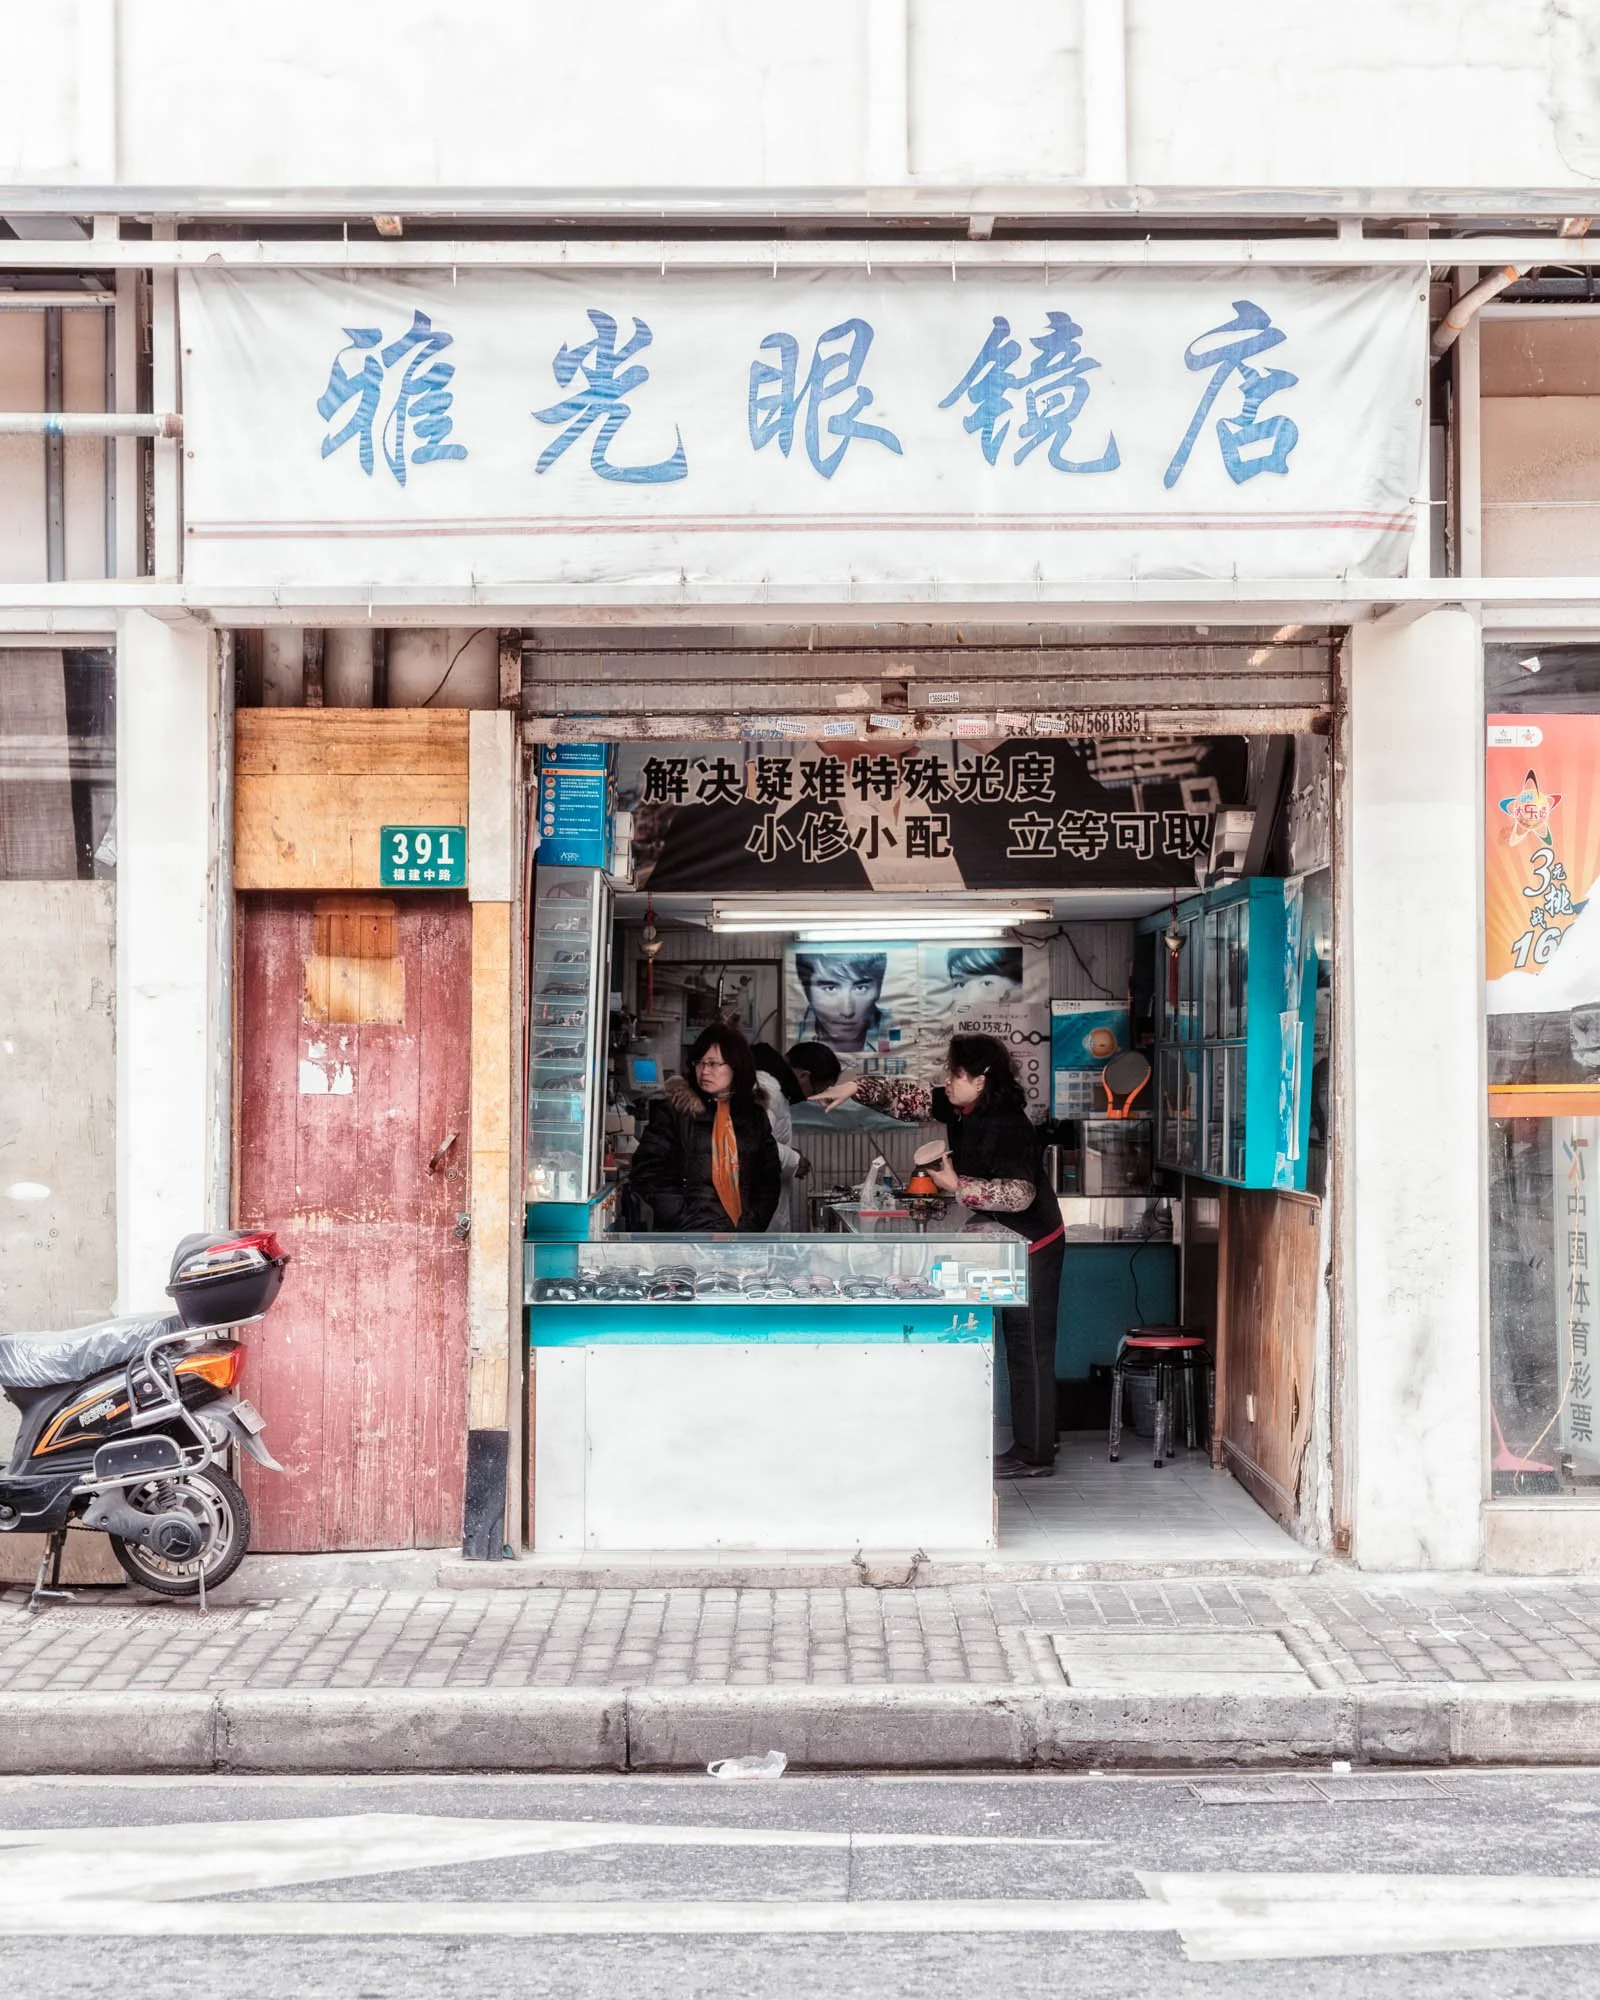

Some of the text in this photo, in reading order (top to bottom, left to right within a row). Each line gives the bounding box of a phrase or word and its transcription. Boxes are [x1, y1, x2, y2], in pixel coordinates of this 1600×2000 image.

[316, 299, 1299, 487] 雅光眼镜店
[642, 752, 1055, 804] 解决疑难特殊光度
[392, 833, 454, 865] 391
[745, 809, 1211, 863] 小修小配 立等可取
[959, 1021, 981, 1031] NEO
[1566, 1193, 1593, 1443] 中国体育彩票
